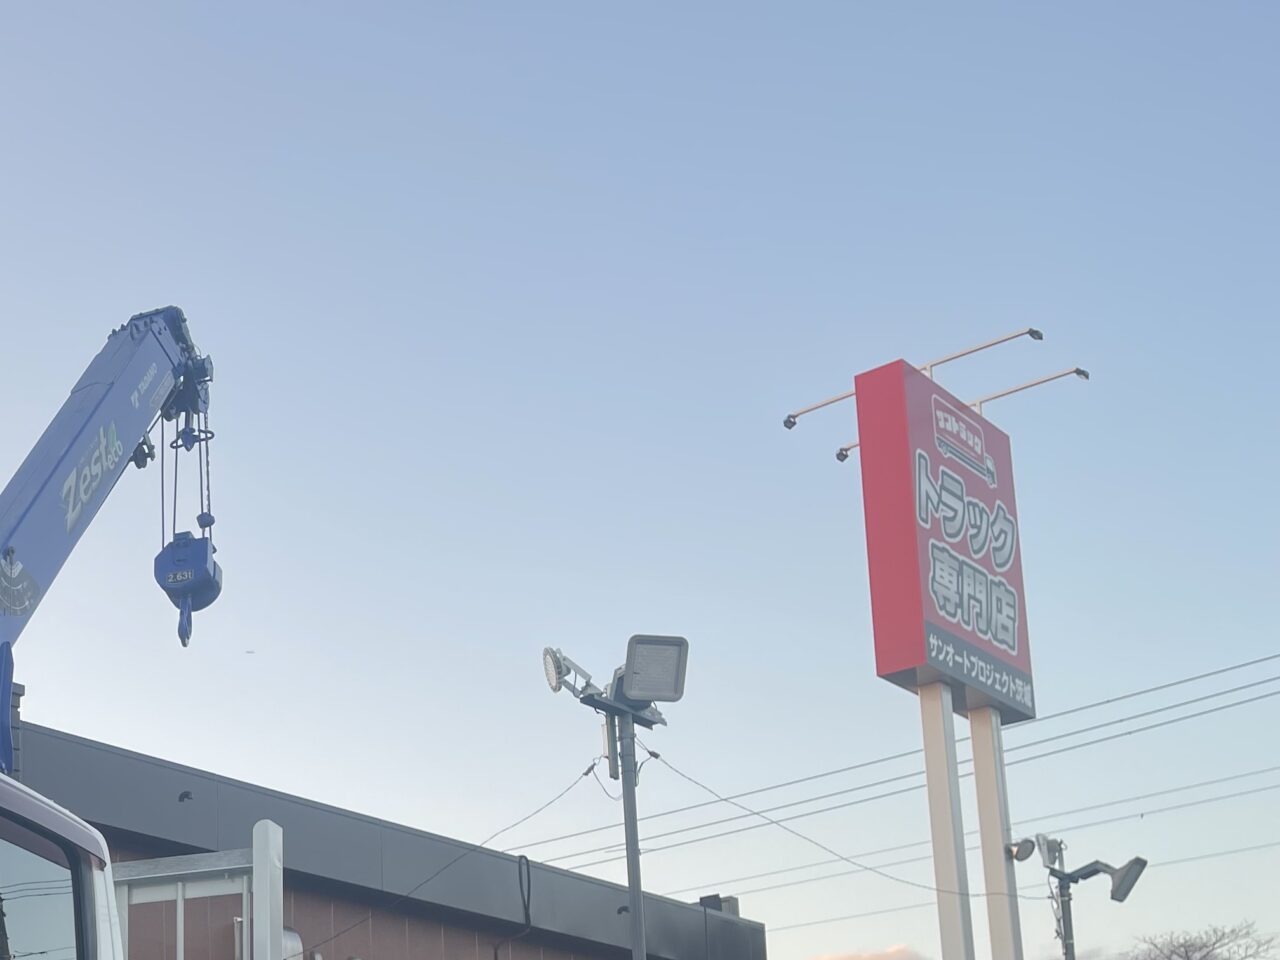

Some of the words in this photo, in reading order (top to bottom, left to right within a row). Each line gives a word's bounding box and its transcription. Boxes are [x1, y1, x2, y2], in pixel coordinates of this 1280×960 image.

[916, 449, 1015, 572] トラック
[929, 538, 1018, 656] 専門店
